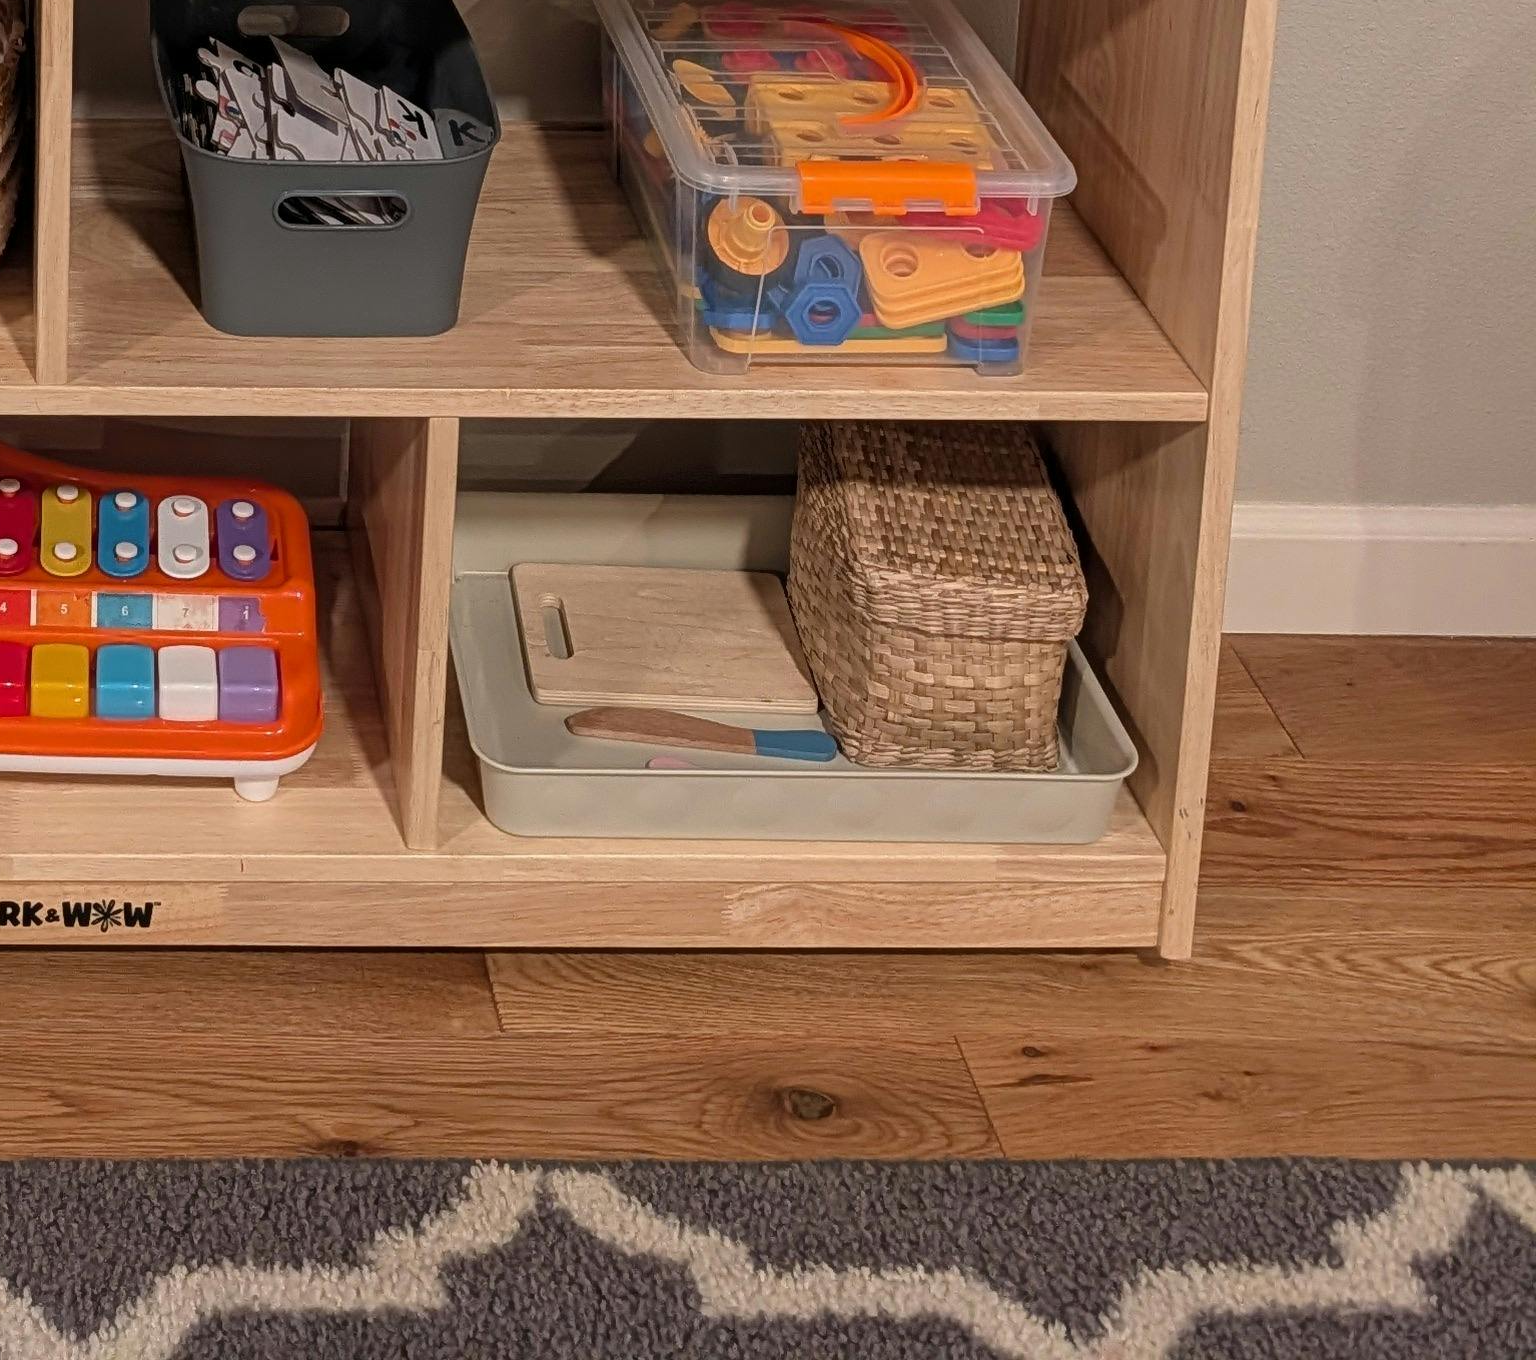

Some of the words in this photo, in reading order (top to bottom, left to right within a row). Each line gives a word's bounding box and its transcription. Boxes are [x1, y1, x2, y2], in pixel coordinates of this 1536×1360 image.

[0, 601, 8, 613] 4
[60, 604, 68, 615] 5
[121, 605, 129, 616] 6
[182, 607, 190, 618] 7
